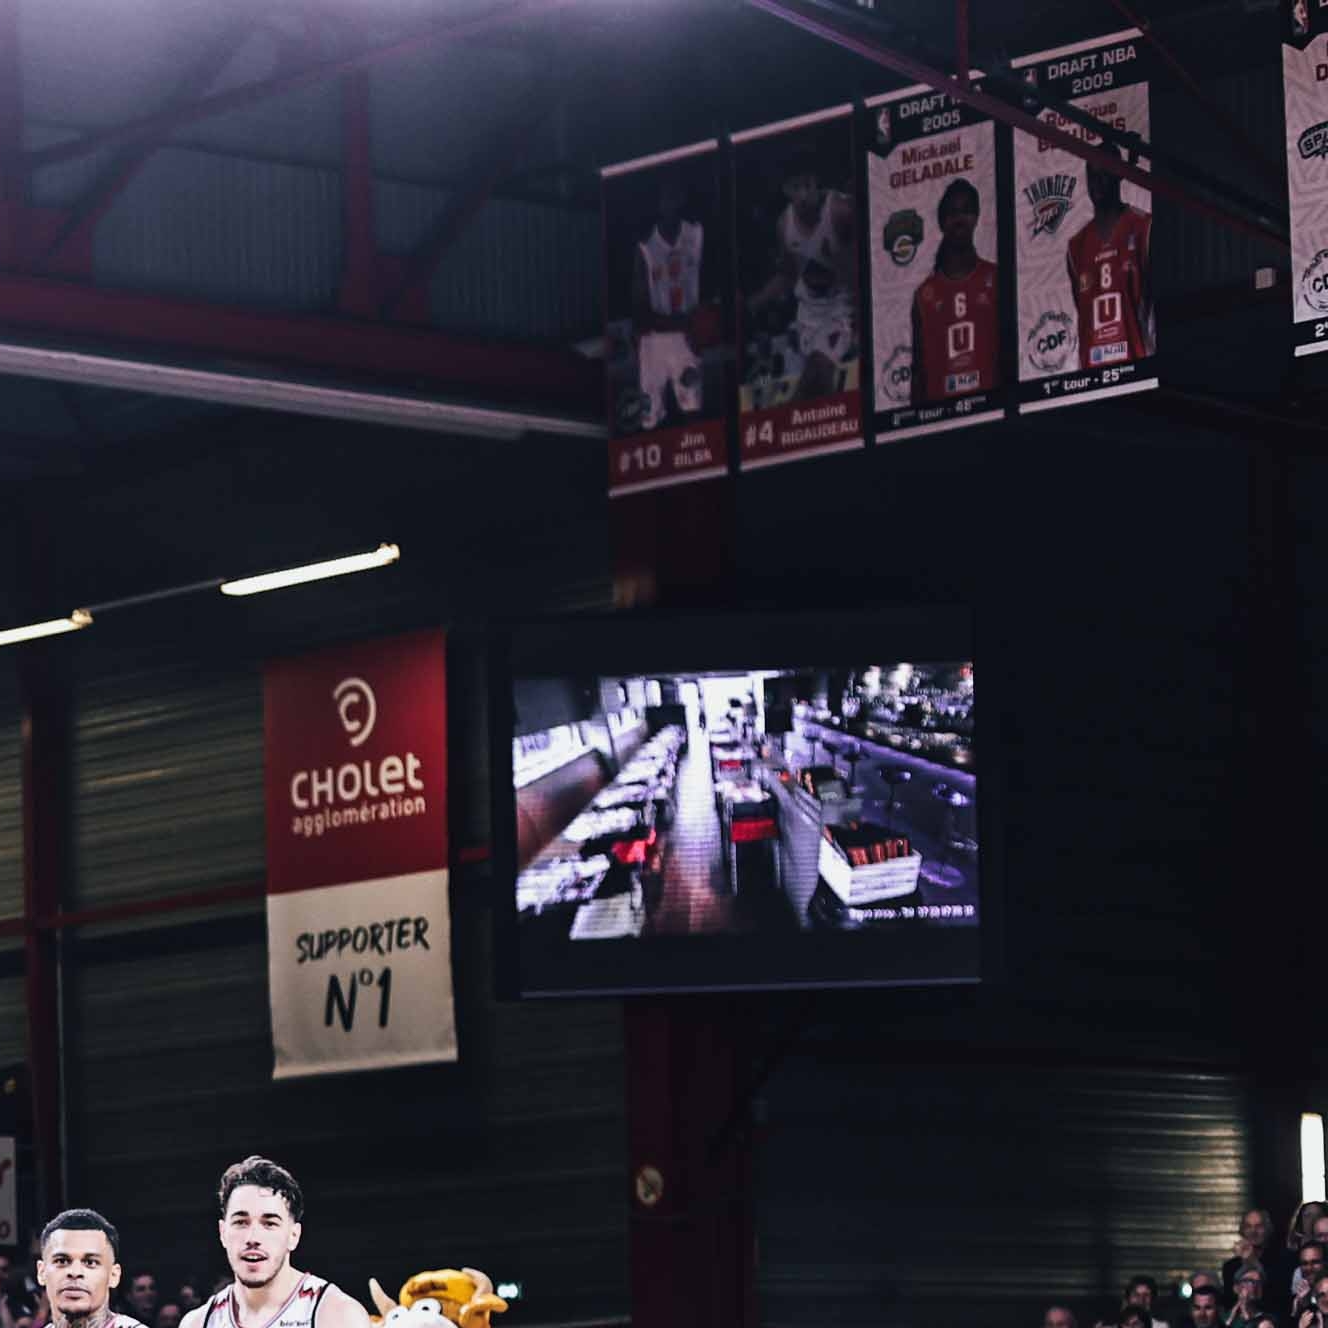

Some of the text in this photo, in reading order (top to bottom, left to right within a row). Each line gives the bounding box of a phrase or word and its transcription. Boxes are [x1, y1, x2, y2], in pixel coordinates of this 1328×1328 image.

[1048, 45, 1136, 80] DRAFT NBA
[1072, 71, 1113, 94] 2009
[899, 93, 946, 119] DRAFT
[923, 109, 960, 132] 2005
[745, 421, 774, 448] #4
[293, 796, 426, 837] agglomération
[296, 917, 430, 964] SUPPORTER
[324, 967, 392, 1032] N°1
